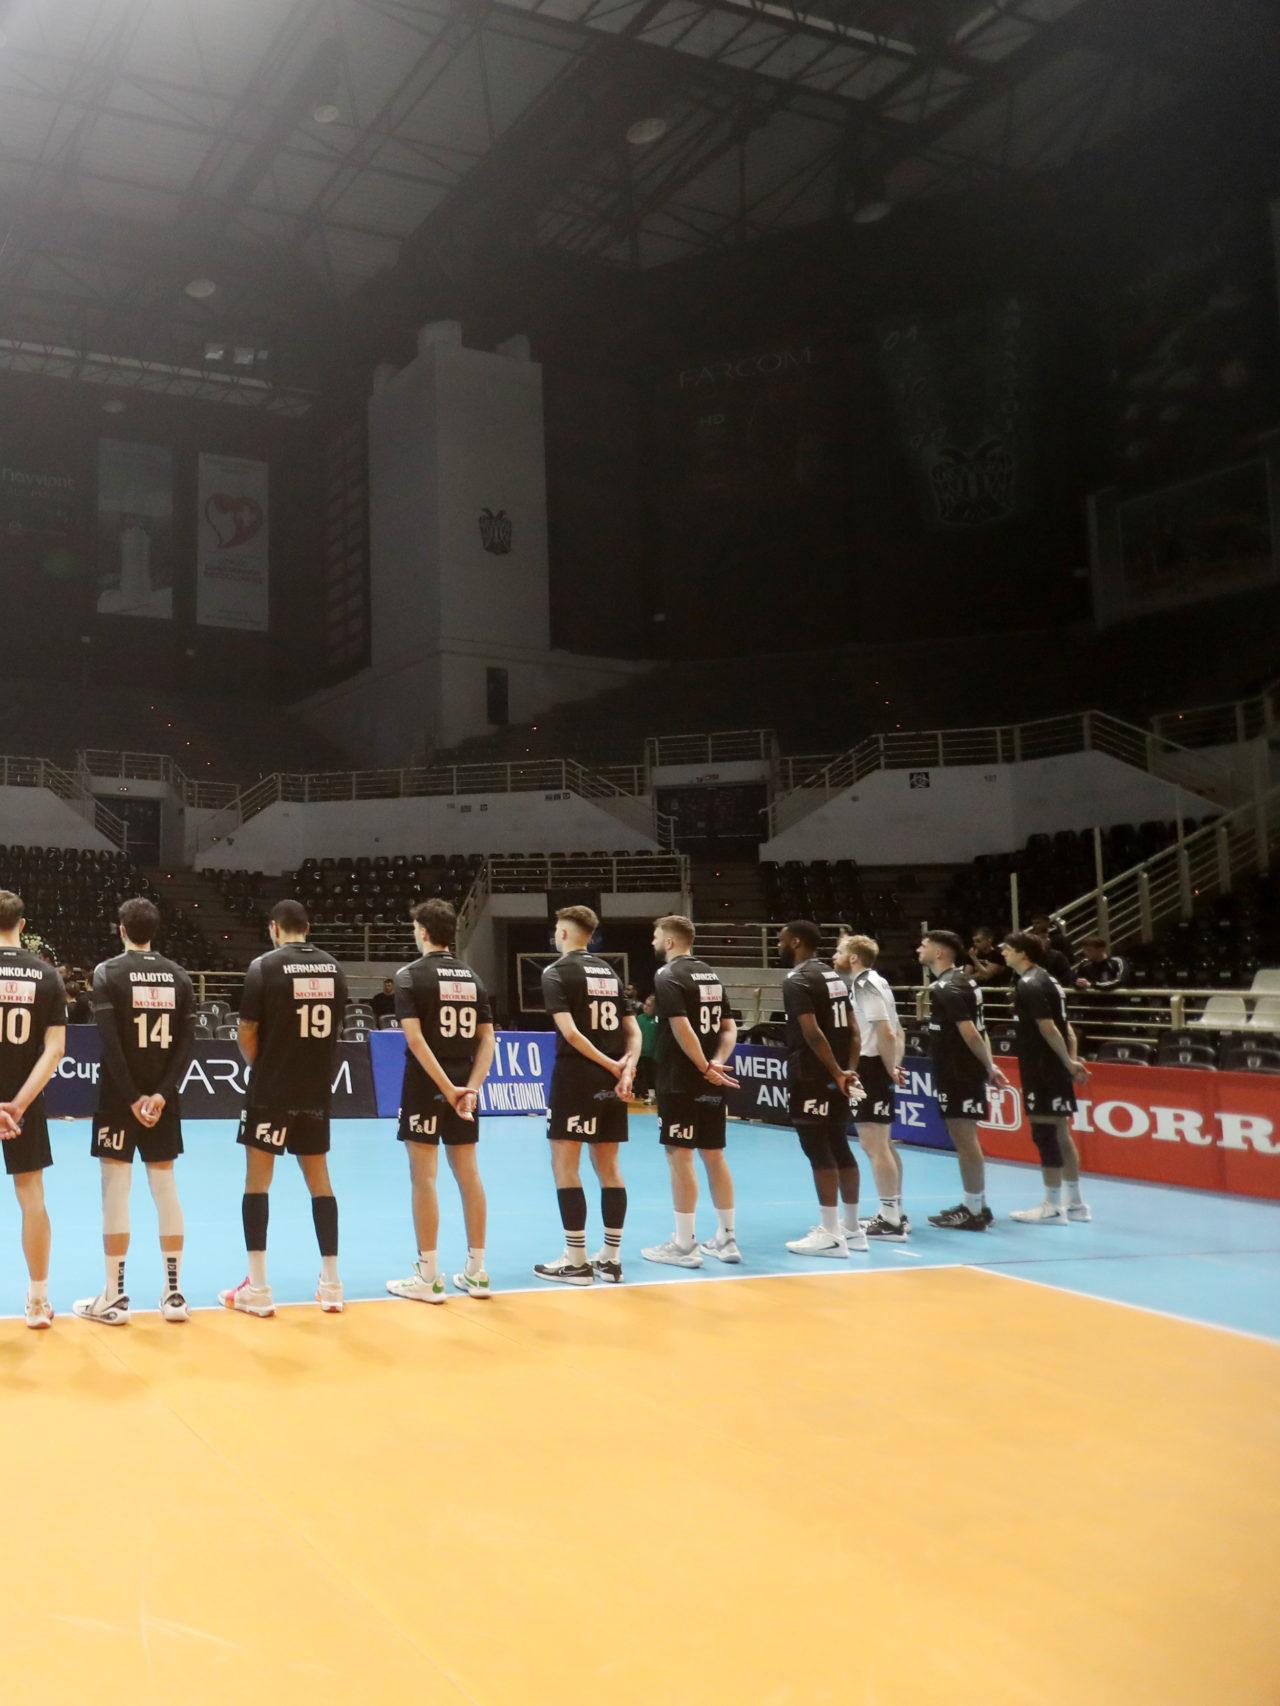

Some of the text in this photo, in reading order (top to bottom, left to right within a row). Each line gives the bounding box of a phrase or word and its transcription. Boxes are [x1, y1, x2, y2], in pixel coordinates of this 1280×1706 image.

[282, 963, 338, 975] HERNANDEZ
[133, 1000, 174, 1008] MORRIS
[588, 1000, 619, 1031] 18
[831, 1001, 848, 1028] 11
[133, 1012, 173, 1049] 14
[296, 1004, 332, 1038] 19
[439, 1005, 477, 1039] 99
[699, 1005, 722, 1034] 93
[803, 1099, 829, 1117] F&U
[1028, 1092, 1035, 1101] 4
[255, 1122, 287, 1146] F&U
[409, 1113, 438, 1135] F&U
[566, 1114, 598, 1136] F&U
[669, 1123, 694, 1140] F&U
[97, 1126, 125, 1151] F&U
